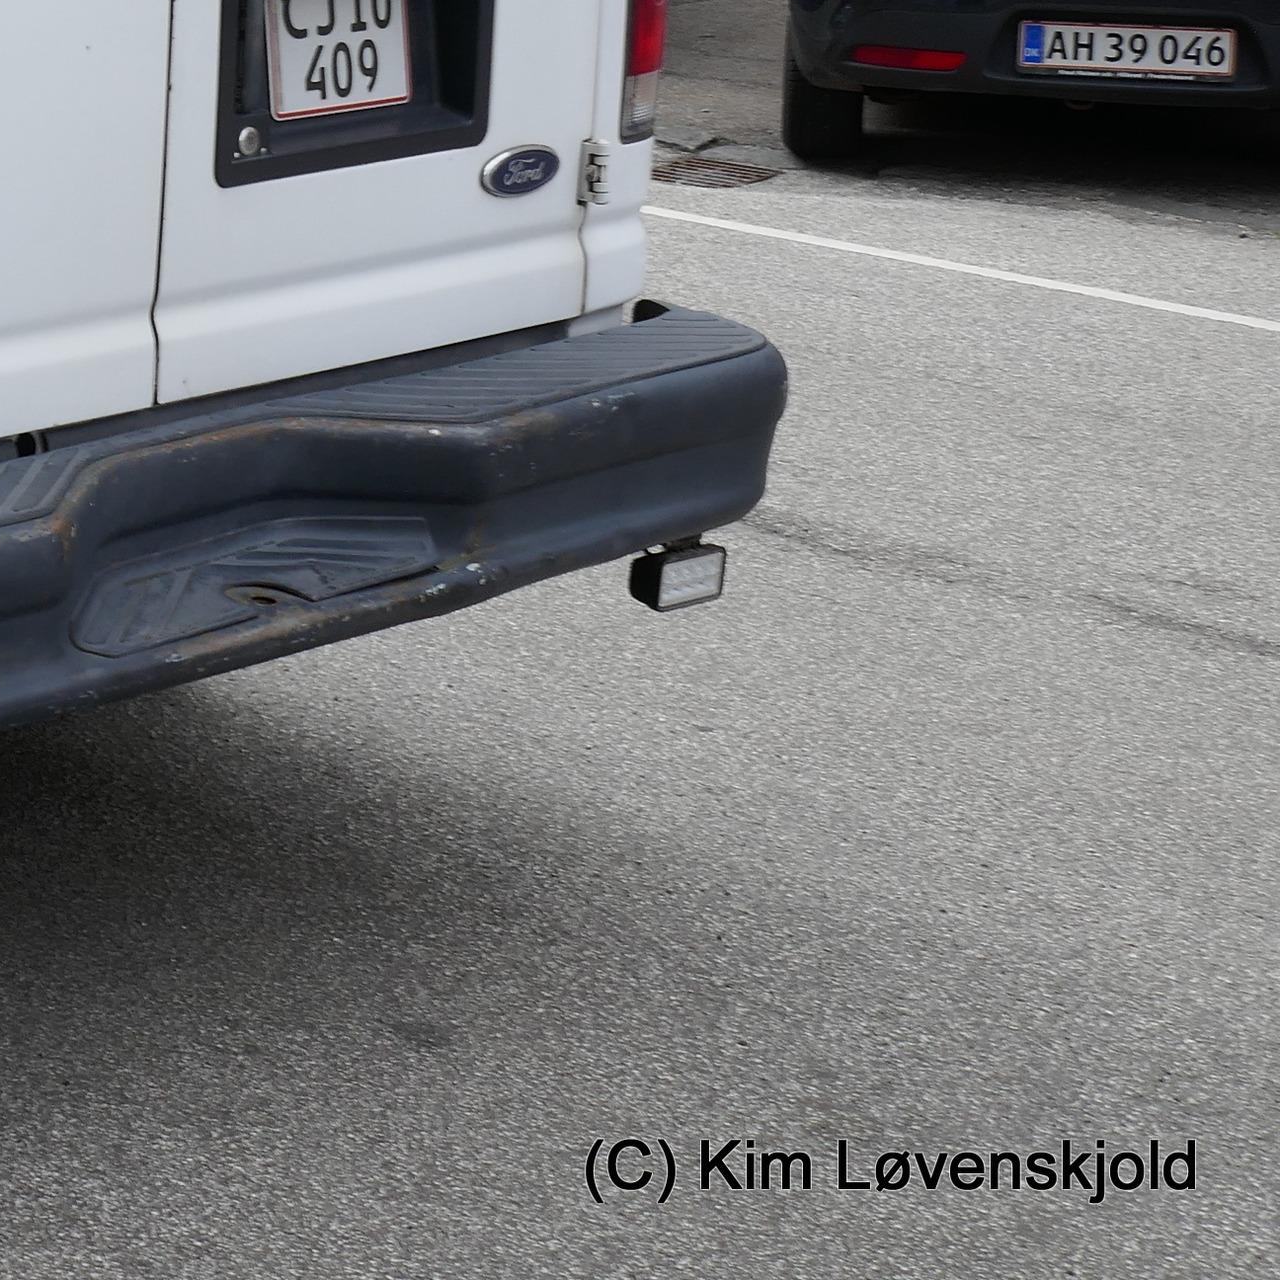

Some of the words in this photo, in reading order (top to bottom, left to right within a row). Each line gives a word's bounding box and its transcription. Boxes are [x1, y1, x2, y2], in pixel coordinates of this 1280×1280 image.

[1045, 31, 1094, 61] AH
[1104, 32, 1148, 63] 39
[1159, 34, 1226, 67] 046
[305, 39, 379, 100] 409
[503, 158, 546, 186] Ford
